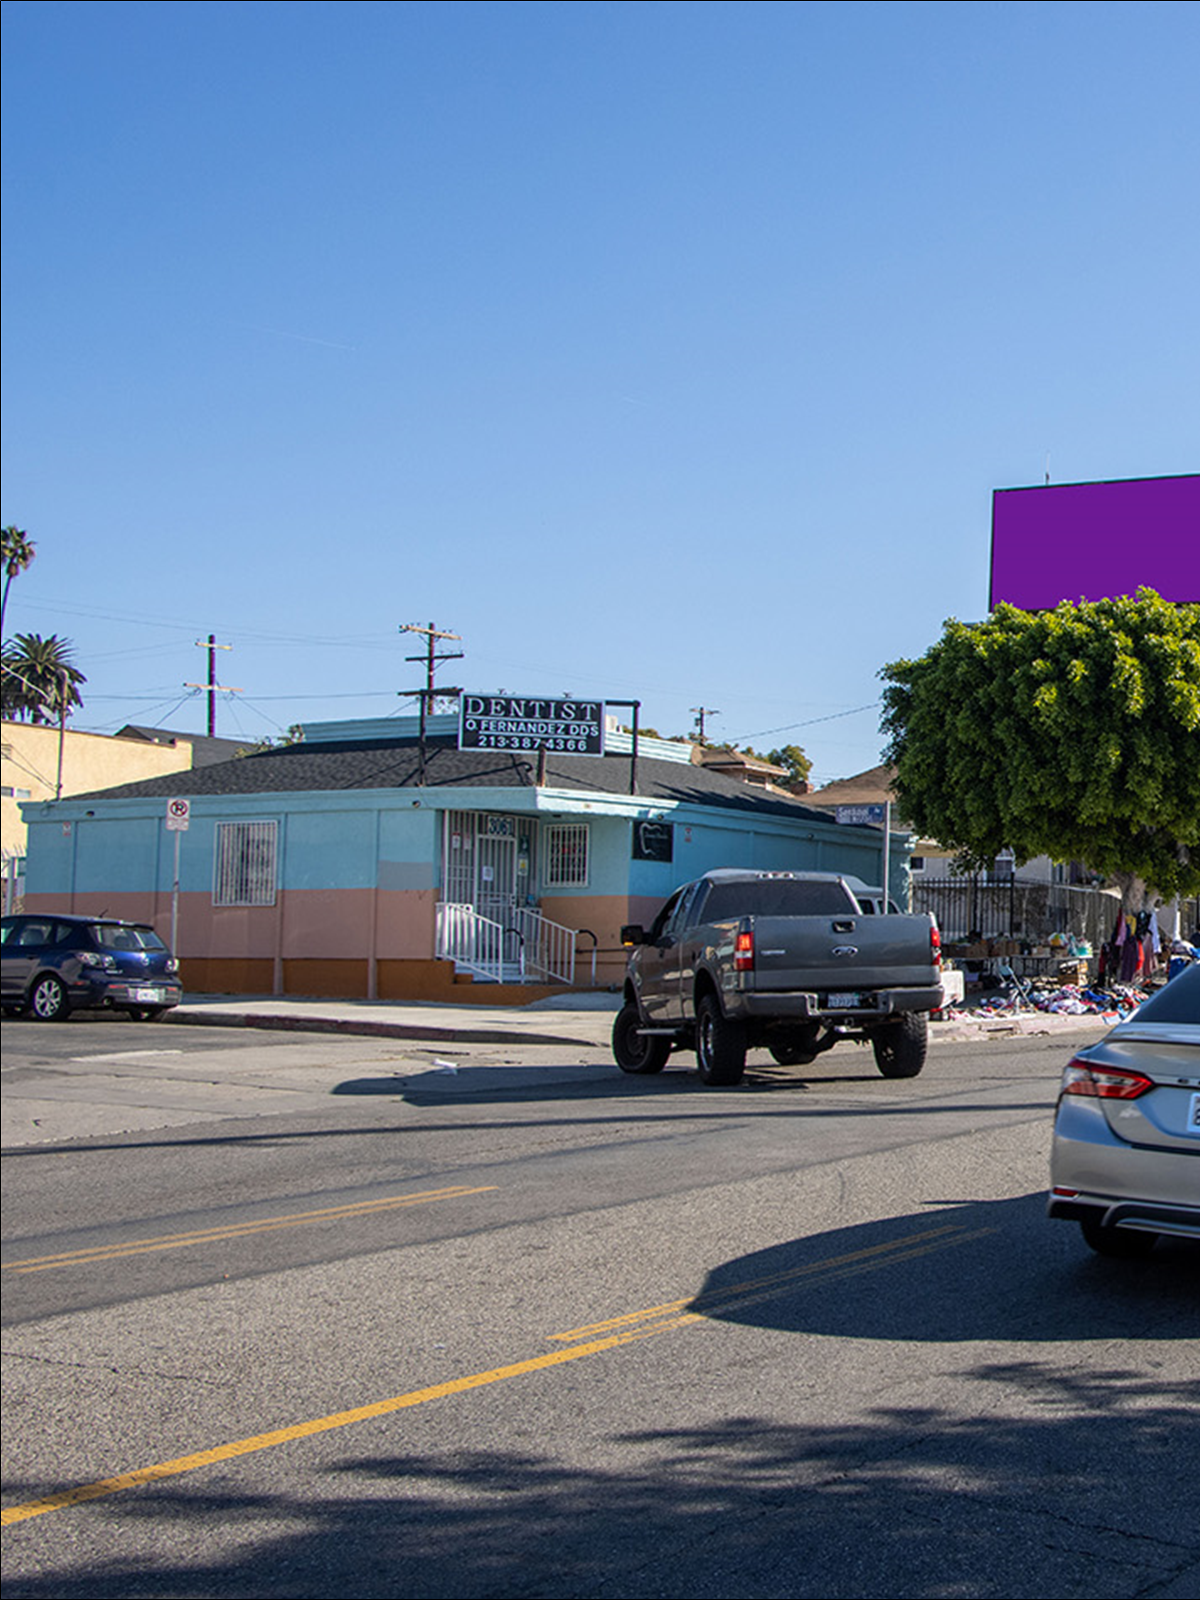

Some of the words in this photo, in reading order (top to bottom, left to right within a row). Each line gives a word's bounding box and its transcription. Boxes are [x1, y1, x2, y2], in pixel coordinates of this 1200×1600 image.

[466, 697, 597, 720] DENTIST
[481, 720, 565, 735] FERNANDEZ
[569, 724, 599, 737] DDS
